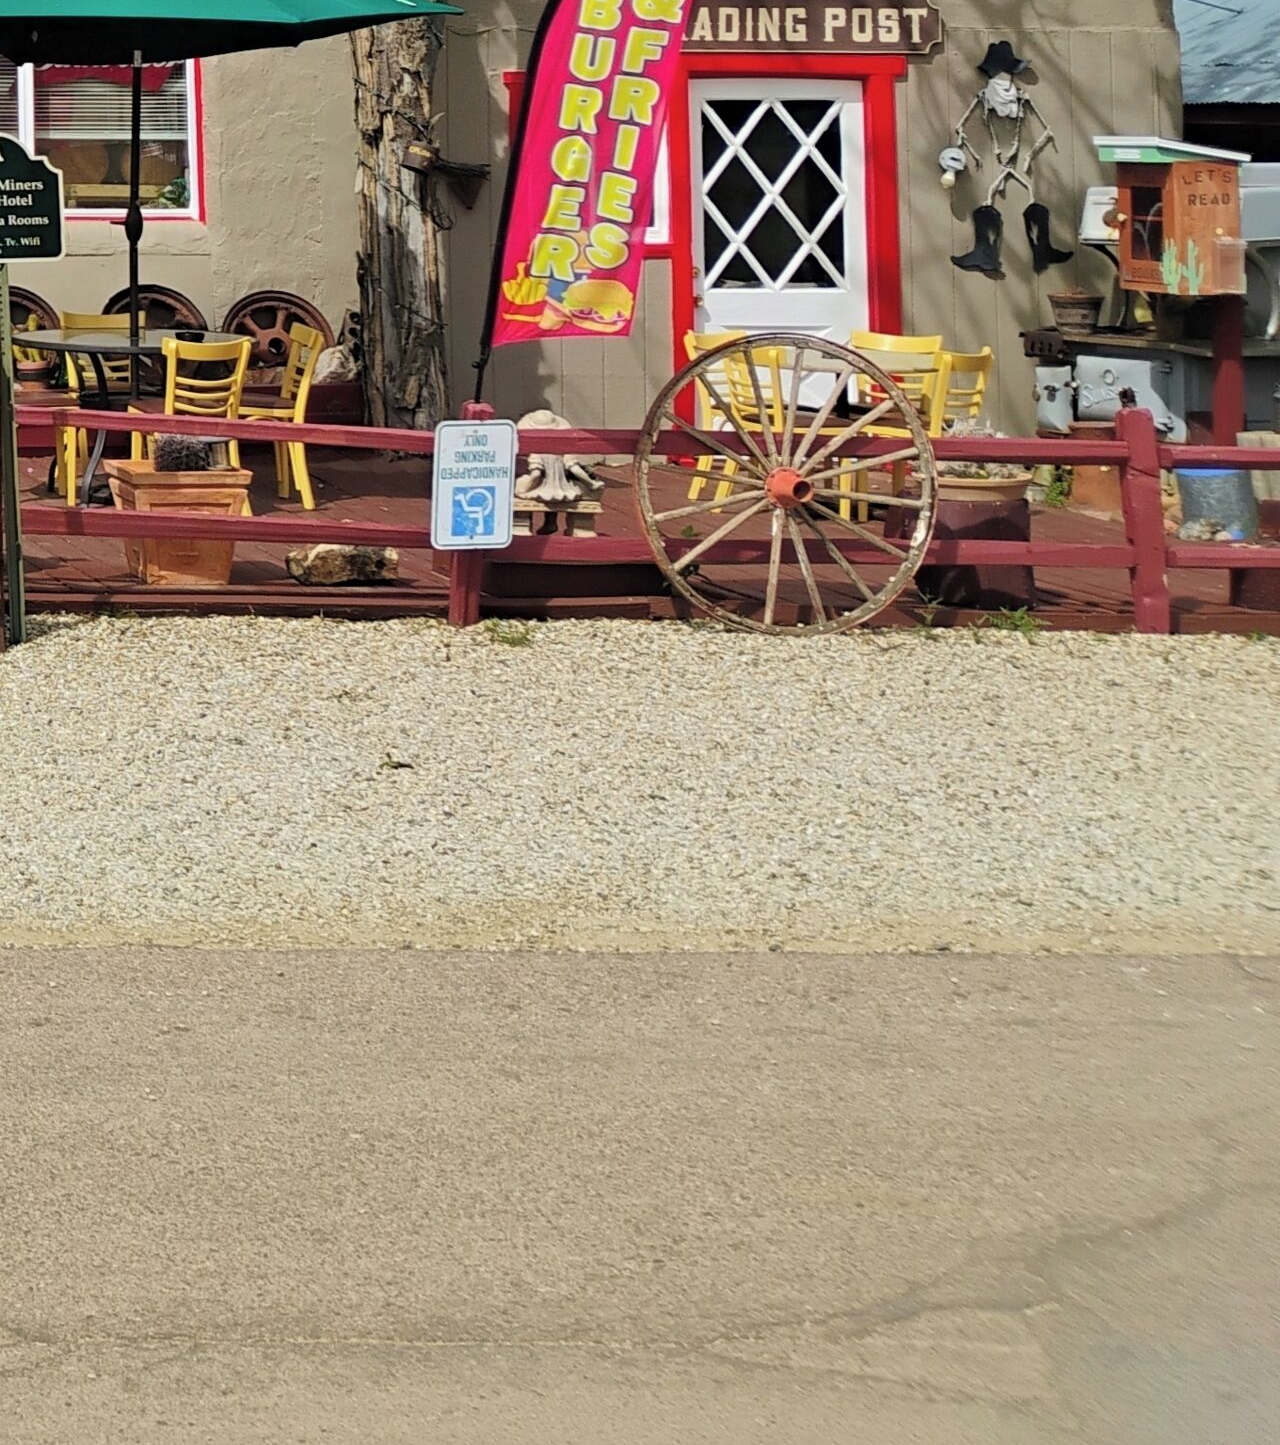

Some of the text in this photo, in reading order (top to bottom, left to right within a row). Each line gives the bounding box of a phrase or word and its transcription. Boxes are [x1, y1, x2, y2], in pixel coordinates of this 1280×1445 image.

[681, 7, 928, 44] ADING POST
[585, 26, 669, 270] FRIES
[1188, 193, 1232, 206] READ
[7, 215, 50, 225] Rooms
[20, 236, 41, 246] Wifi
[463, 434, 488, 447] ONLY
[454, 451, 497, 463] PARKING
[440, 466, 509, 480] HANDICAPPED
